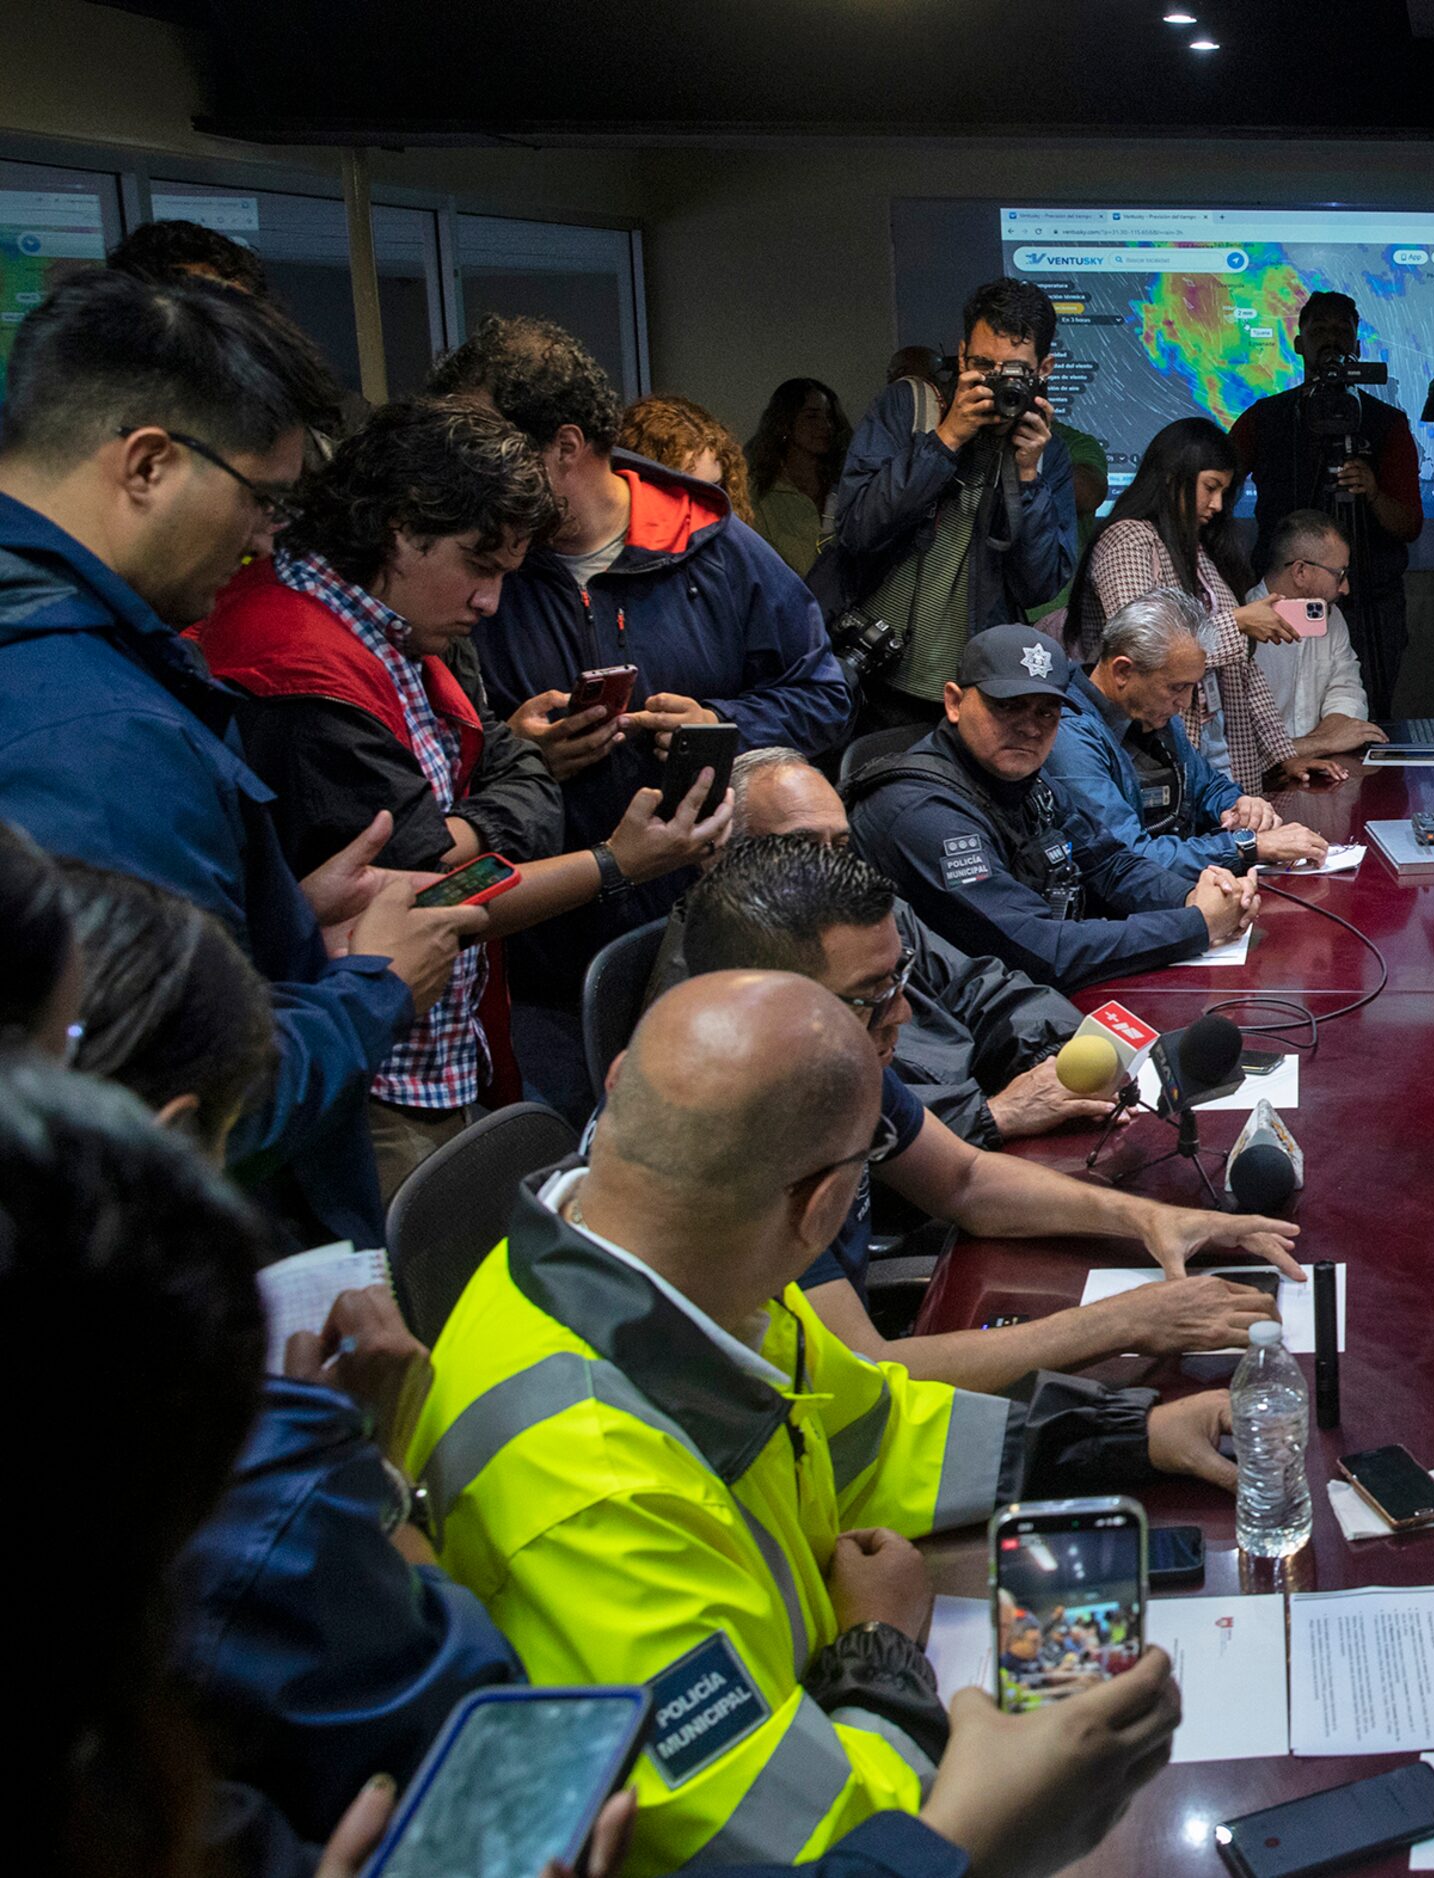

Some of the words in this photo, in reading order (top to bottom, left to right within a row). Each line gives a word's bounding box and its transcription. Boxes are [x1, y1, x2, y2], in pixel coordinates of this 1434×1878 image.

[1047, 256, 1104, 265] VENTUSKY
[1408, 253, 1422, 262] App
[947, 853, 982, 869] POLICÍA
[946, 864, 989, 880] MUNICIPAL
[656, 1671, 727, 1729] POLICÍA
[656, 1686, 753, 1760] MUNICIPAL
